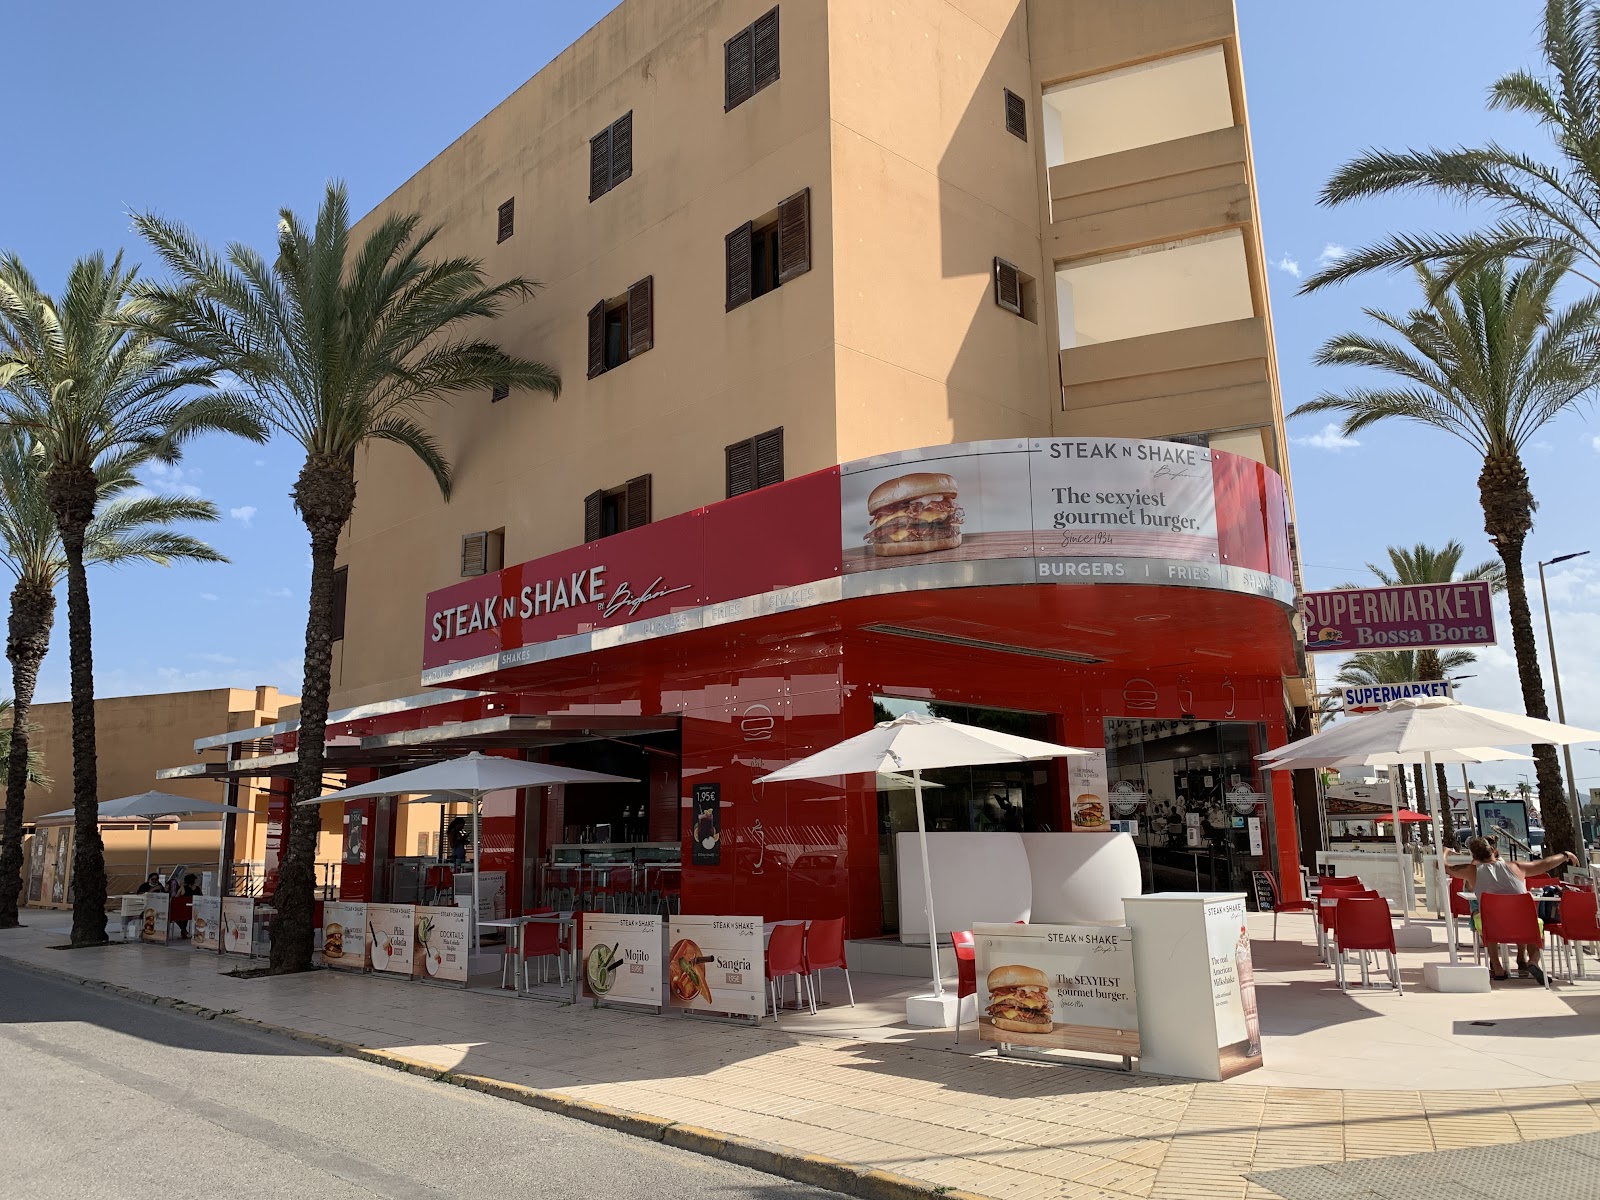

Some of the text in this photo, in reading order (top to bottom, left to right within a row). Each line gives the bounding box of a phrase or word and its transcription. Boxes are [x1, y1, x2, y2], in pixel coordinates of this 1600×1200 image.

[1050, 442, 1196, 466] STEAK N SHAKE
[1052, 486, 1166, 509] The sexyiest
[1053, 508, 1200, 533] gourmet burger.
[1061, 529, 1094, 547] Since
[1039, 562, 1279, 594] BURGERS FRIES SHAKES
[431, 565, 606, 643] STEAK N SHAKE
[711, 603, 741, 621] FRIES
[768, 587, 816, 609] SHAKES
[1304, 585, 1484, 627] SUPERMARKET
[1355, 622, 1490, 646] Bossa Bora
[502, 650, 531, 665] SHAKES
[1345, 682, 1449, 705] SUPERMARKET
[1207, 905, 1223, 916] STEAK
[1225, 903, 1241, 913] SHAKE
[620, 919, 635, 927] STEAK
[638, 920, 655, 928] SHAKE
[713, 921, 731, 929] STEAK
[734, 922, 754, 930] SHAKE
[440, 930, 464, 940] COCKTAILS
[1047, 933, 1077, 943] STEAK
[1085, 934, 1118, 945] SHAKE
[624, 948, 650, 964] Mojito
[1211, 957, 1220, 966] The
[716, 955, 751, 974] Sangria
[1213, 966, 1233, 976] American
[1056, 974, 1121, 987] The SEXYIEST
[1213, 975, 1236, 987] Milkshake
[1057, 987, 1129, 1002] gourmet burger.
